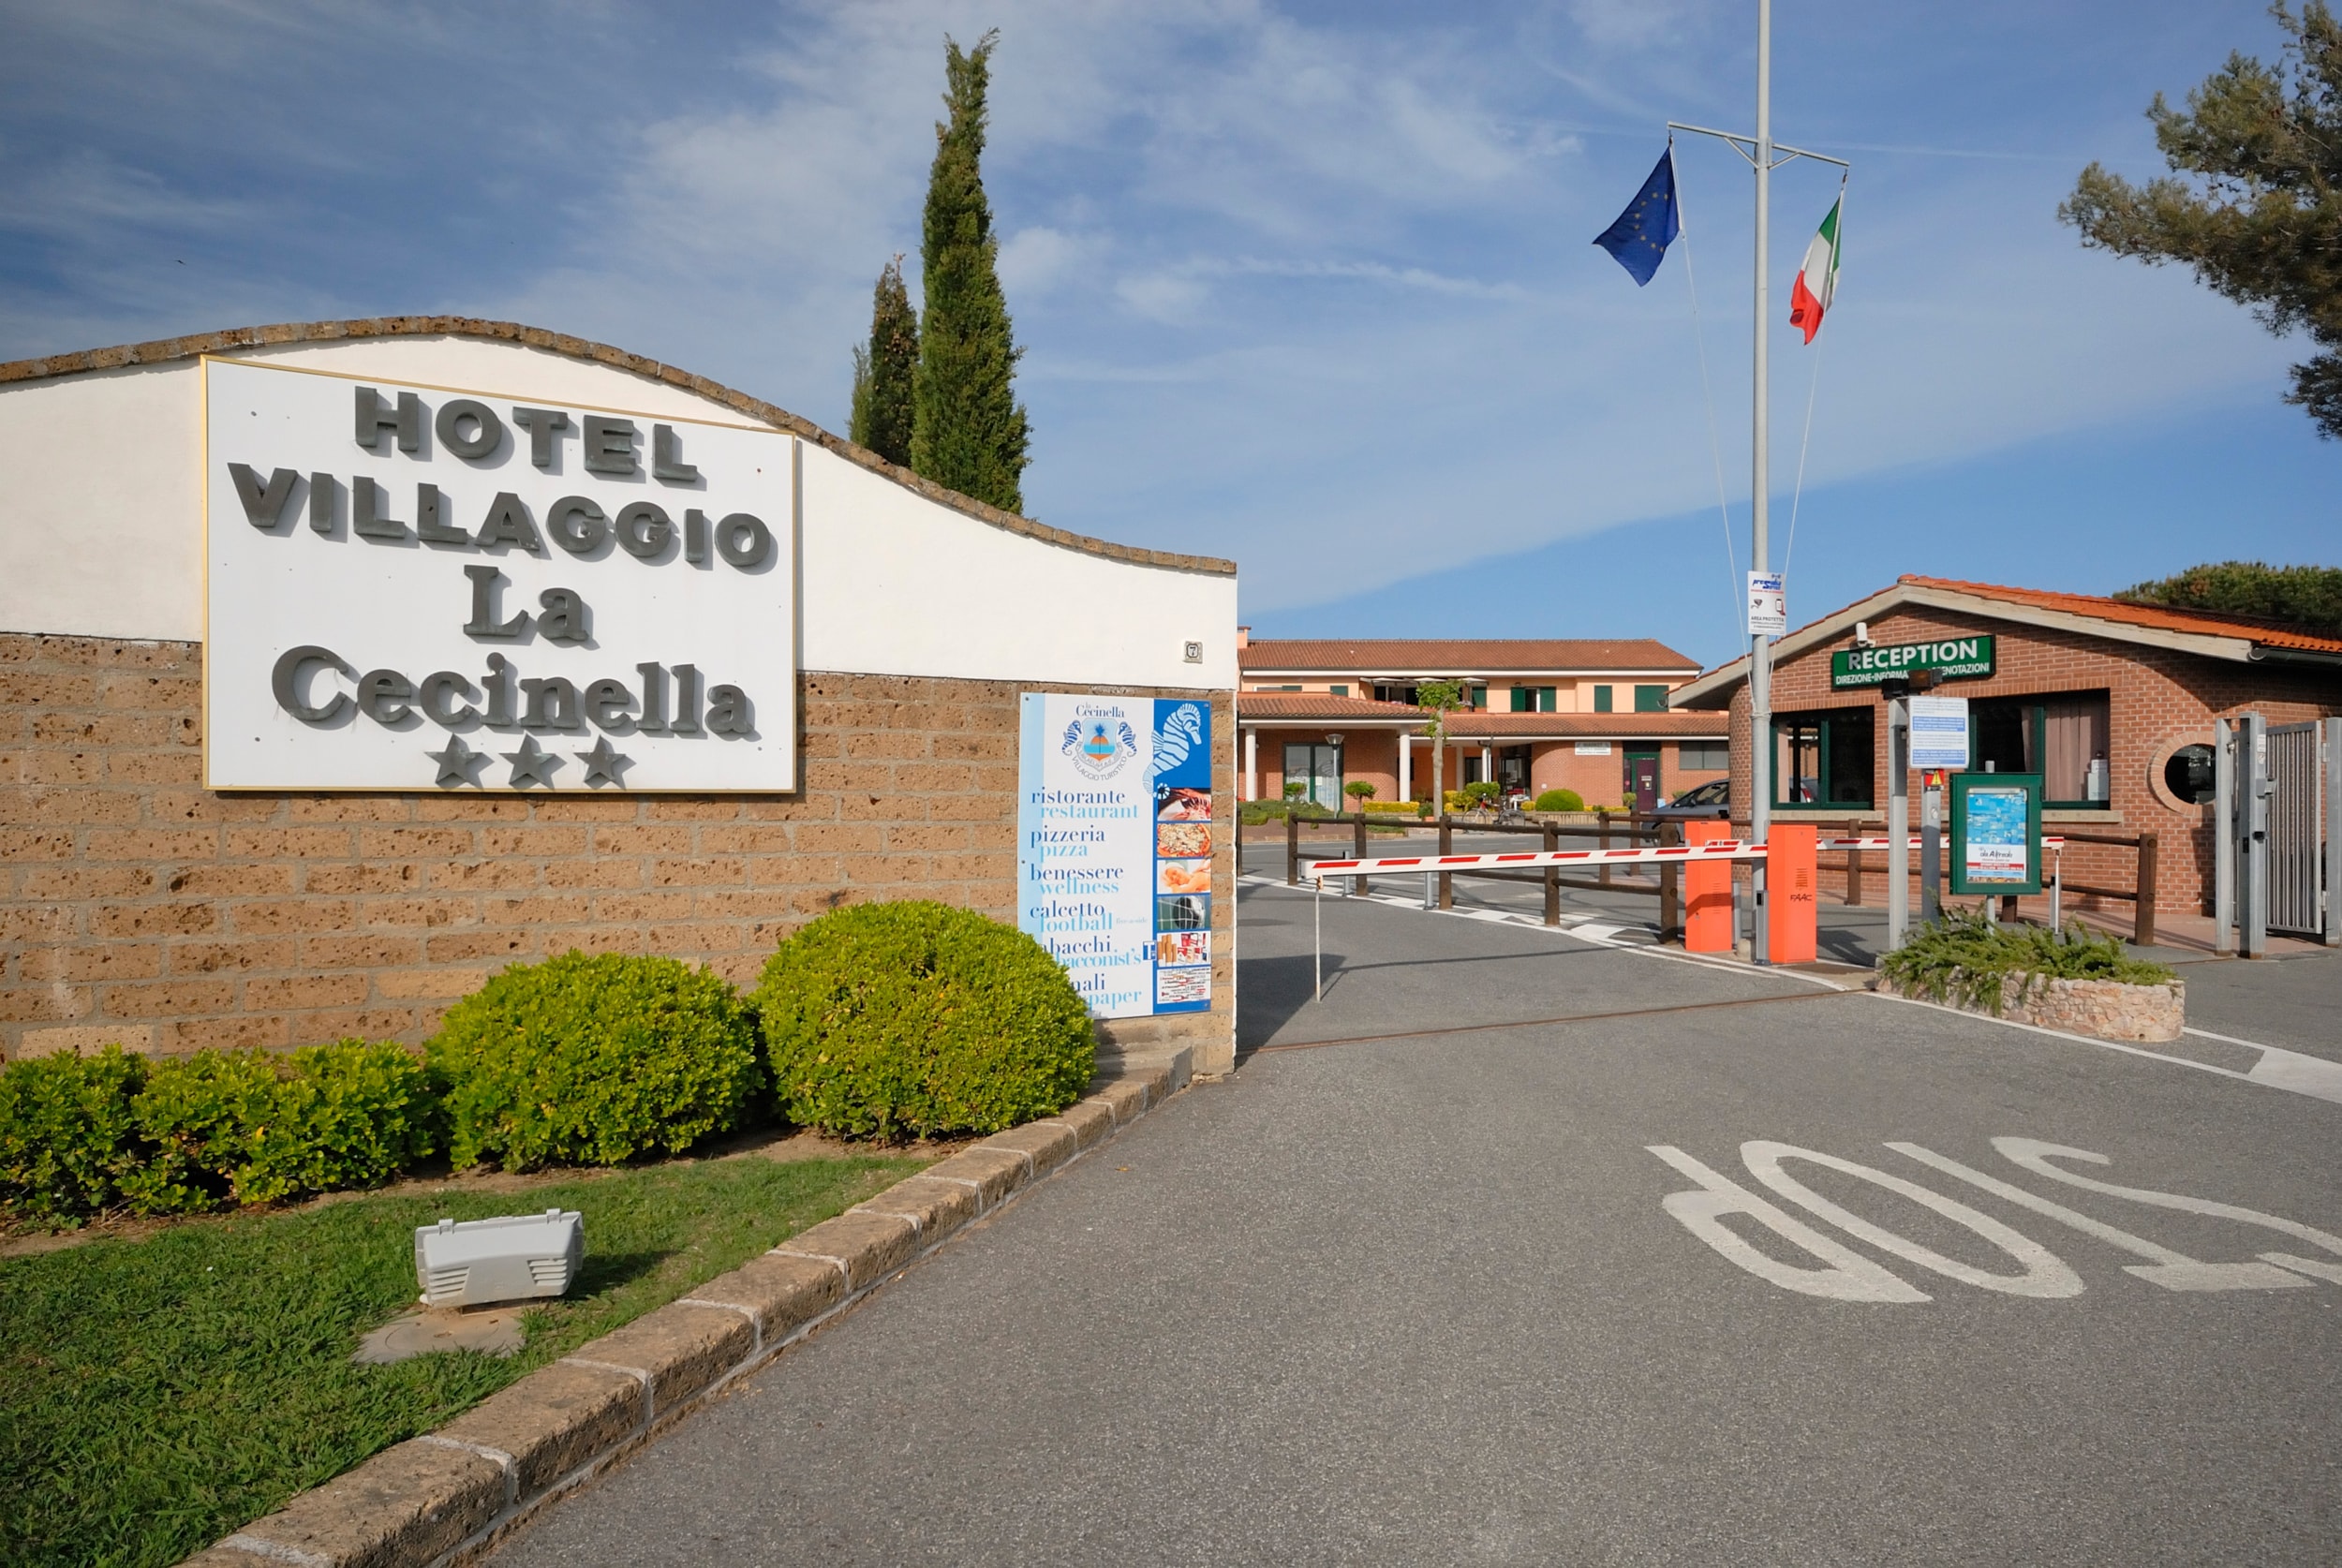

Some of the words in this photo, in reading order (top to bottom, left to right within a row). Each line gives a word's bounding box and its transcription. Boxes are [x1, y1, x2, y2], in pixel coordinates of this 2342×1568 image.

[354, 385, 699, 482] HOTEL
[227, 462, 772, 568] VILLAGGIO
[463, 565, 589, 642] La
[1846, 640, 1978, 671] RECEPTION
[272, 644, 755, 735] Cecinella
[1075, 704, 1125, 717] Cecinella
[1072, 756, 1099, 781] VILLAGGIO
[1031, 787, 1125, 804] ristorante
[1041, 804, 1139, 819] restaurant
[1030, 825, 1105, 849] pizzeria
[1040, 839, 1088, 863] pizza
[1030, 864, 1124, 881] benessere
[1040, 877, 1119, 895] wellness
[1030, 900, 1104, 919] calcetto
[1040, 912, 1113, 933] football
[1039, 935, 1110, 954] abacchi
[1055, 947, 1142, 969] bacconist's
[1071, 972, 1104, 992] nali
[1089, 991, 1142, 1011] paper
